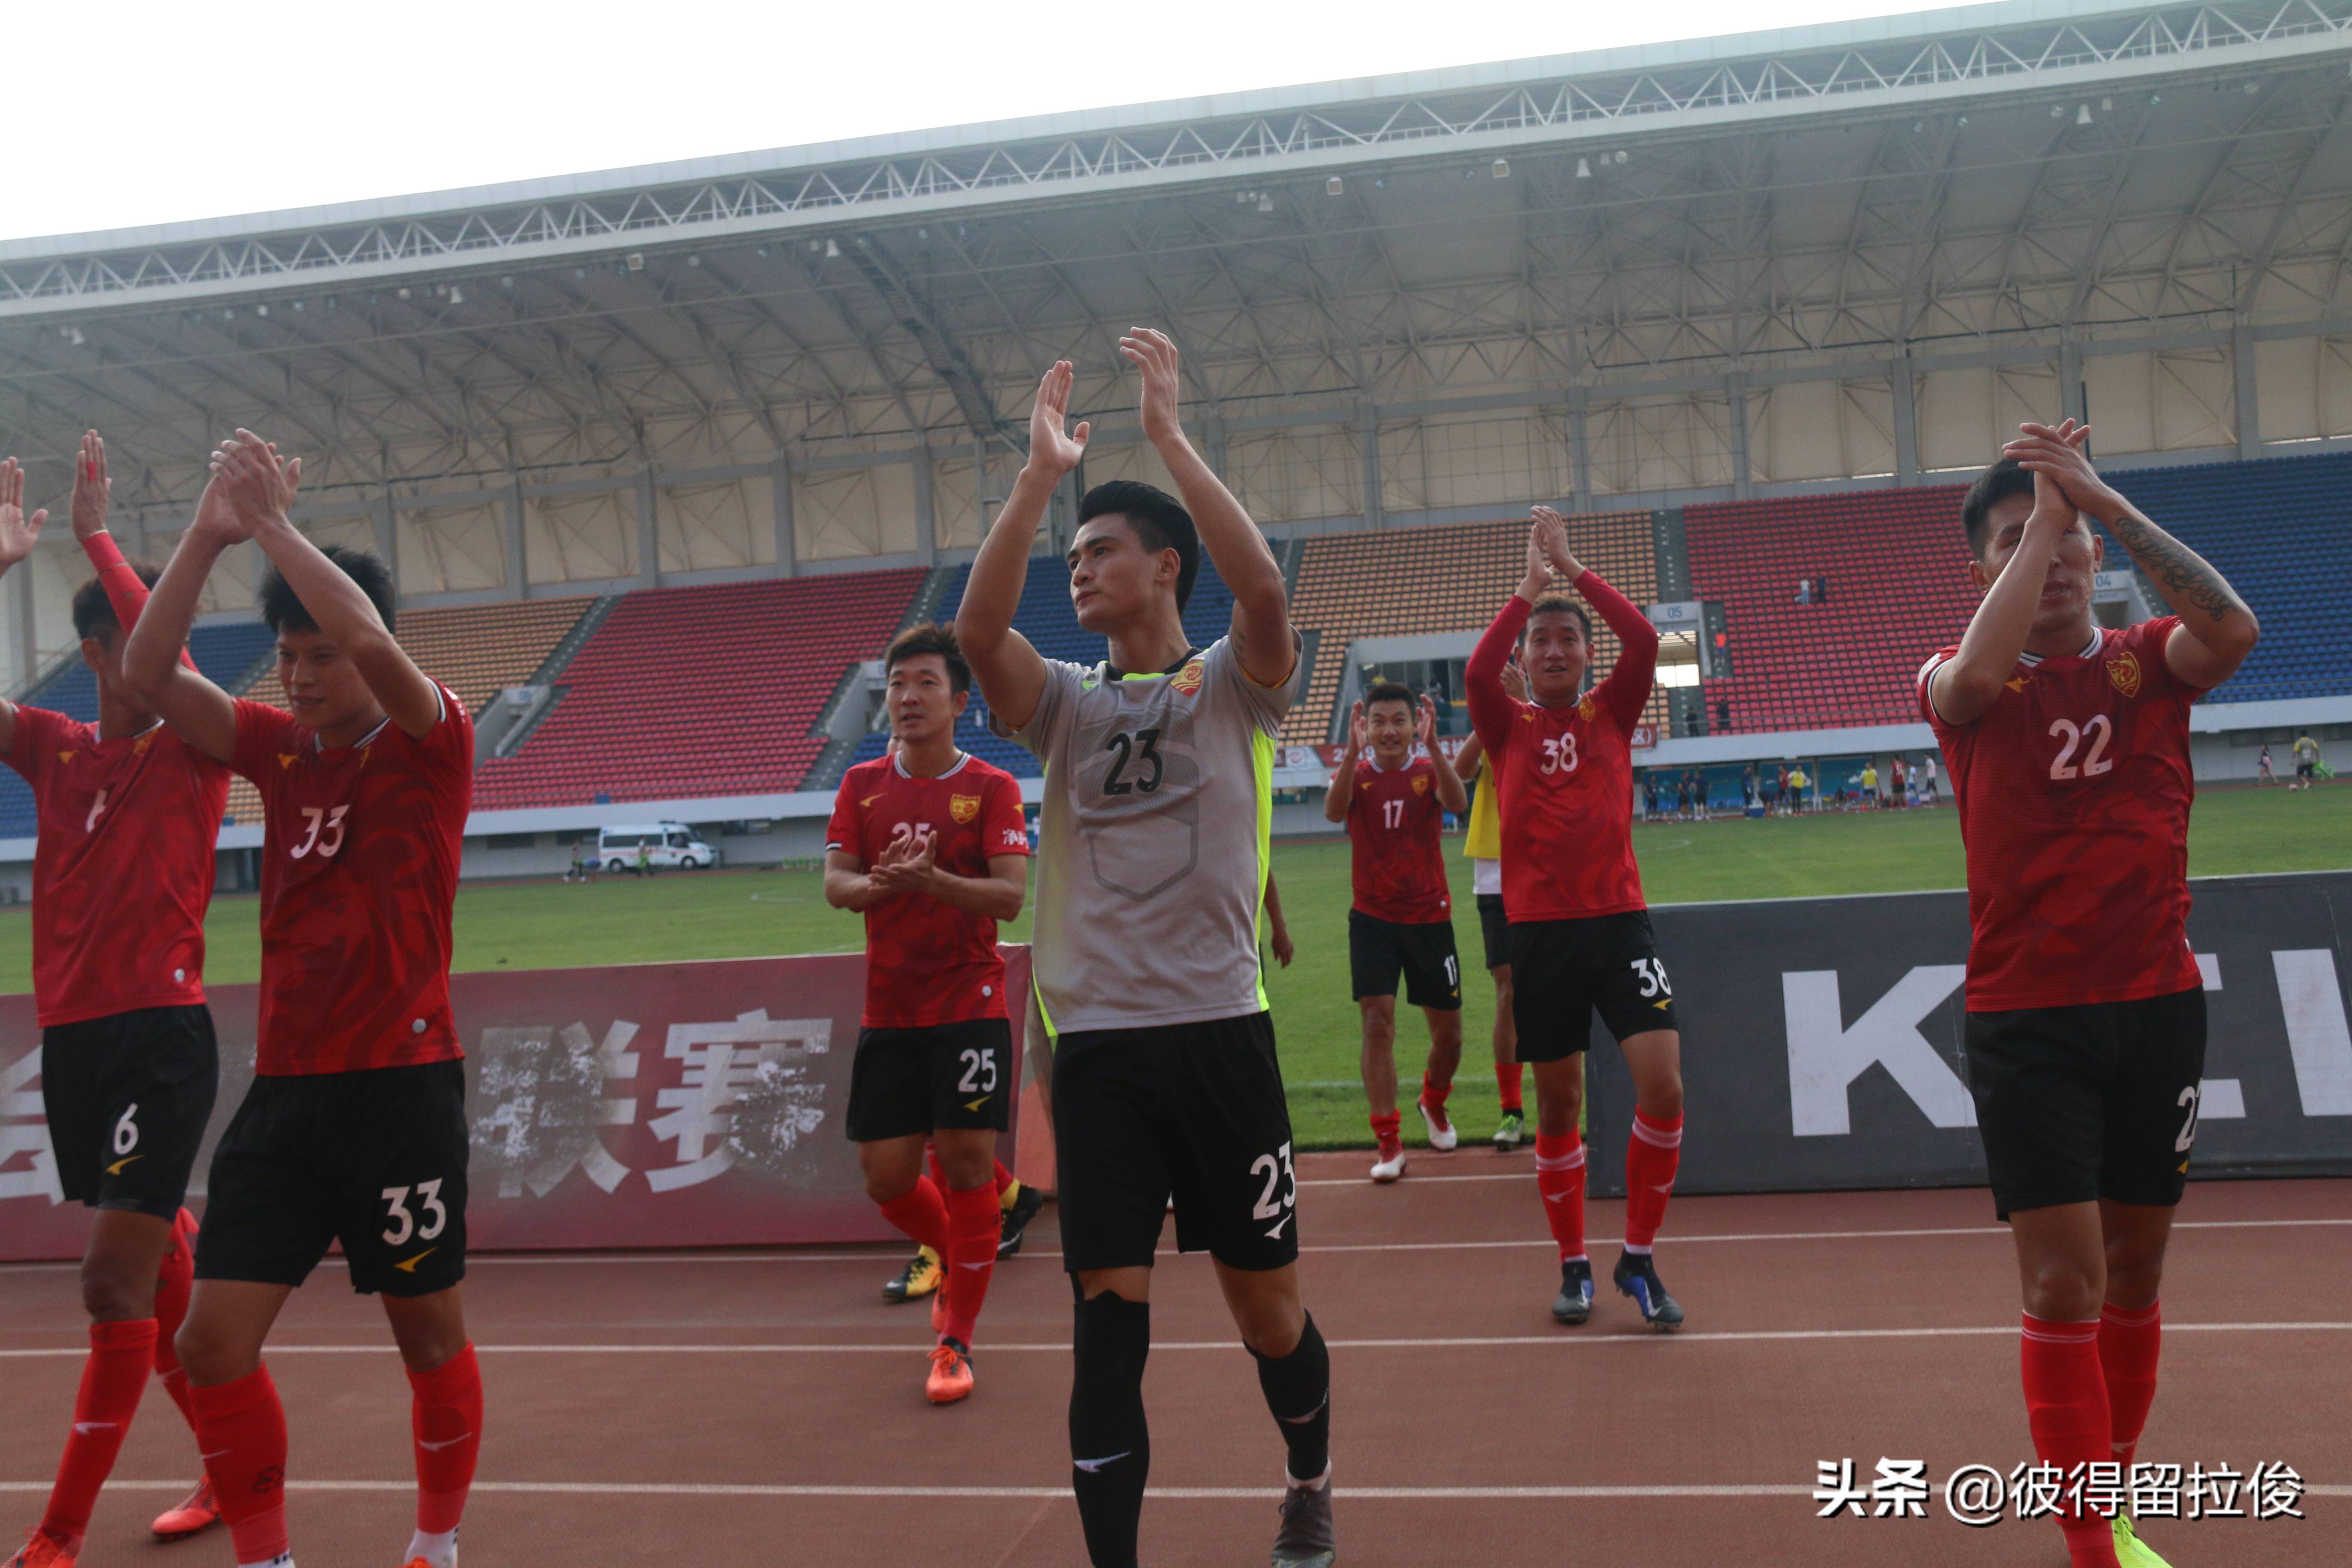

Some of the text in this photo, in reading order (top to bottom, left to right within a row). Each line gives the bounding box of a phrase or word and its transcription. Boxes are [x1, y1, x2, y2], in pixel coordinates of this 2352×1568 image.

[1668, 606, 1682, 619] 05
[1103, 728, 1163, 796] 23
[1540, 732, 1578, 775] 38
[2049, 714, 2113, 780] 22
[289, 804, 350, 859] 33
[1382, 799, 1404, 829] 17
[1631, 957, 1672, 998] 38
[958, 1048, 997, 1092] 25
[113, 1102, 139, 1155] 6
[1250, 1140, 1296, 1220] 23
[380, 1178, 447, 1246] 33
